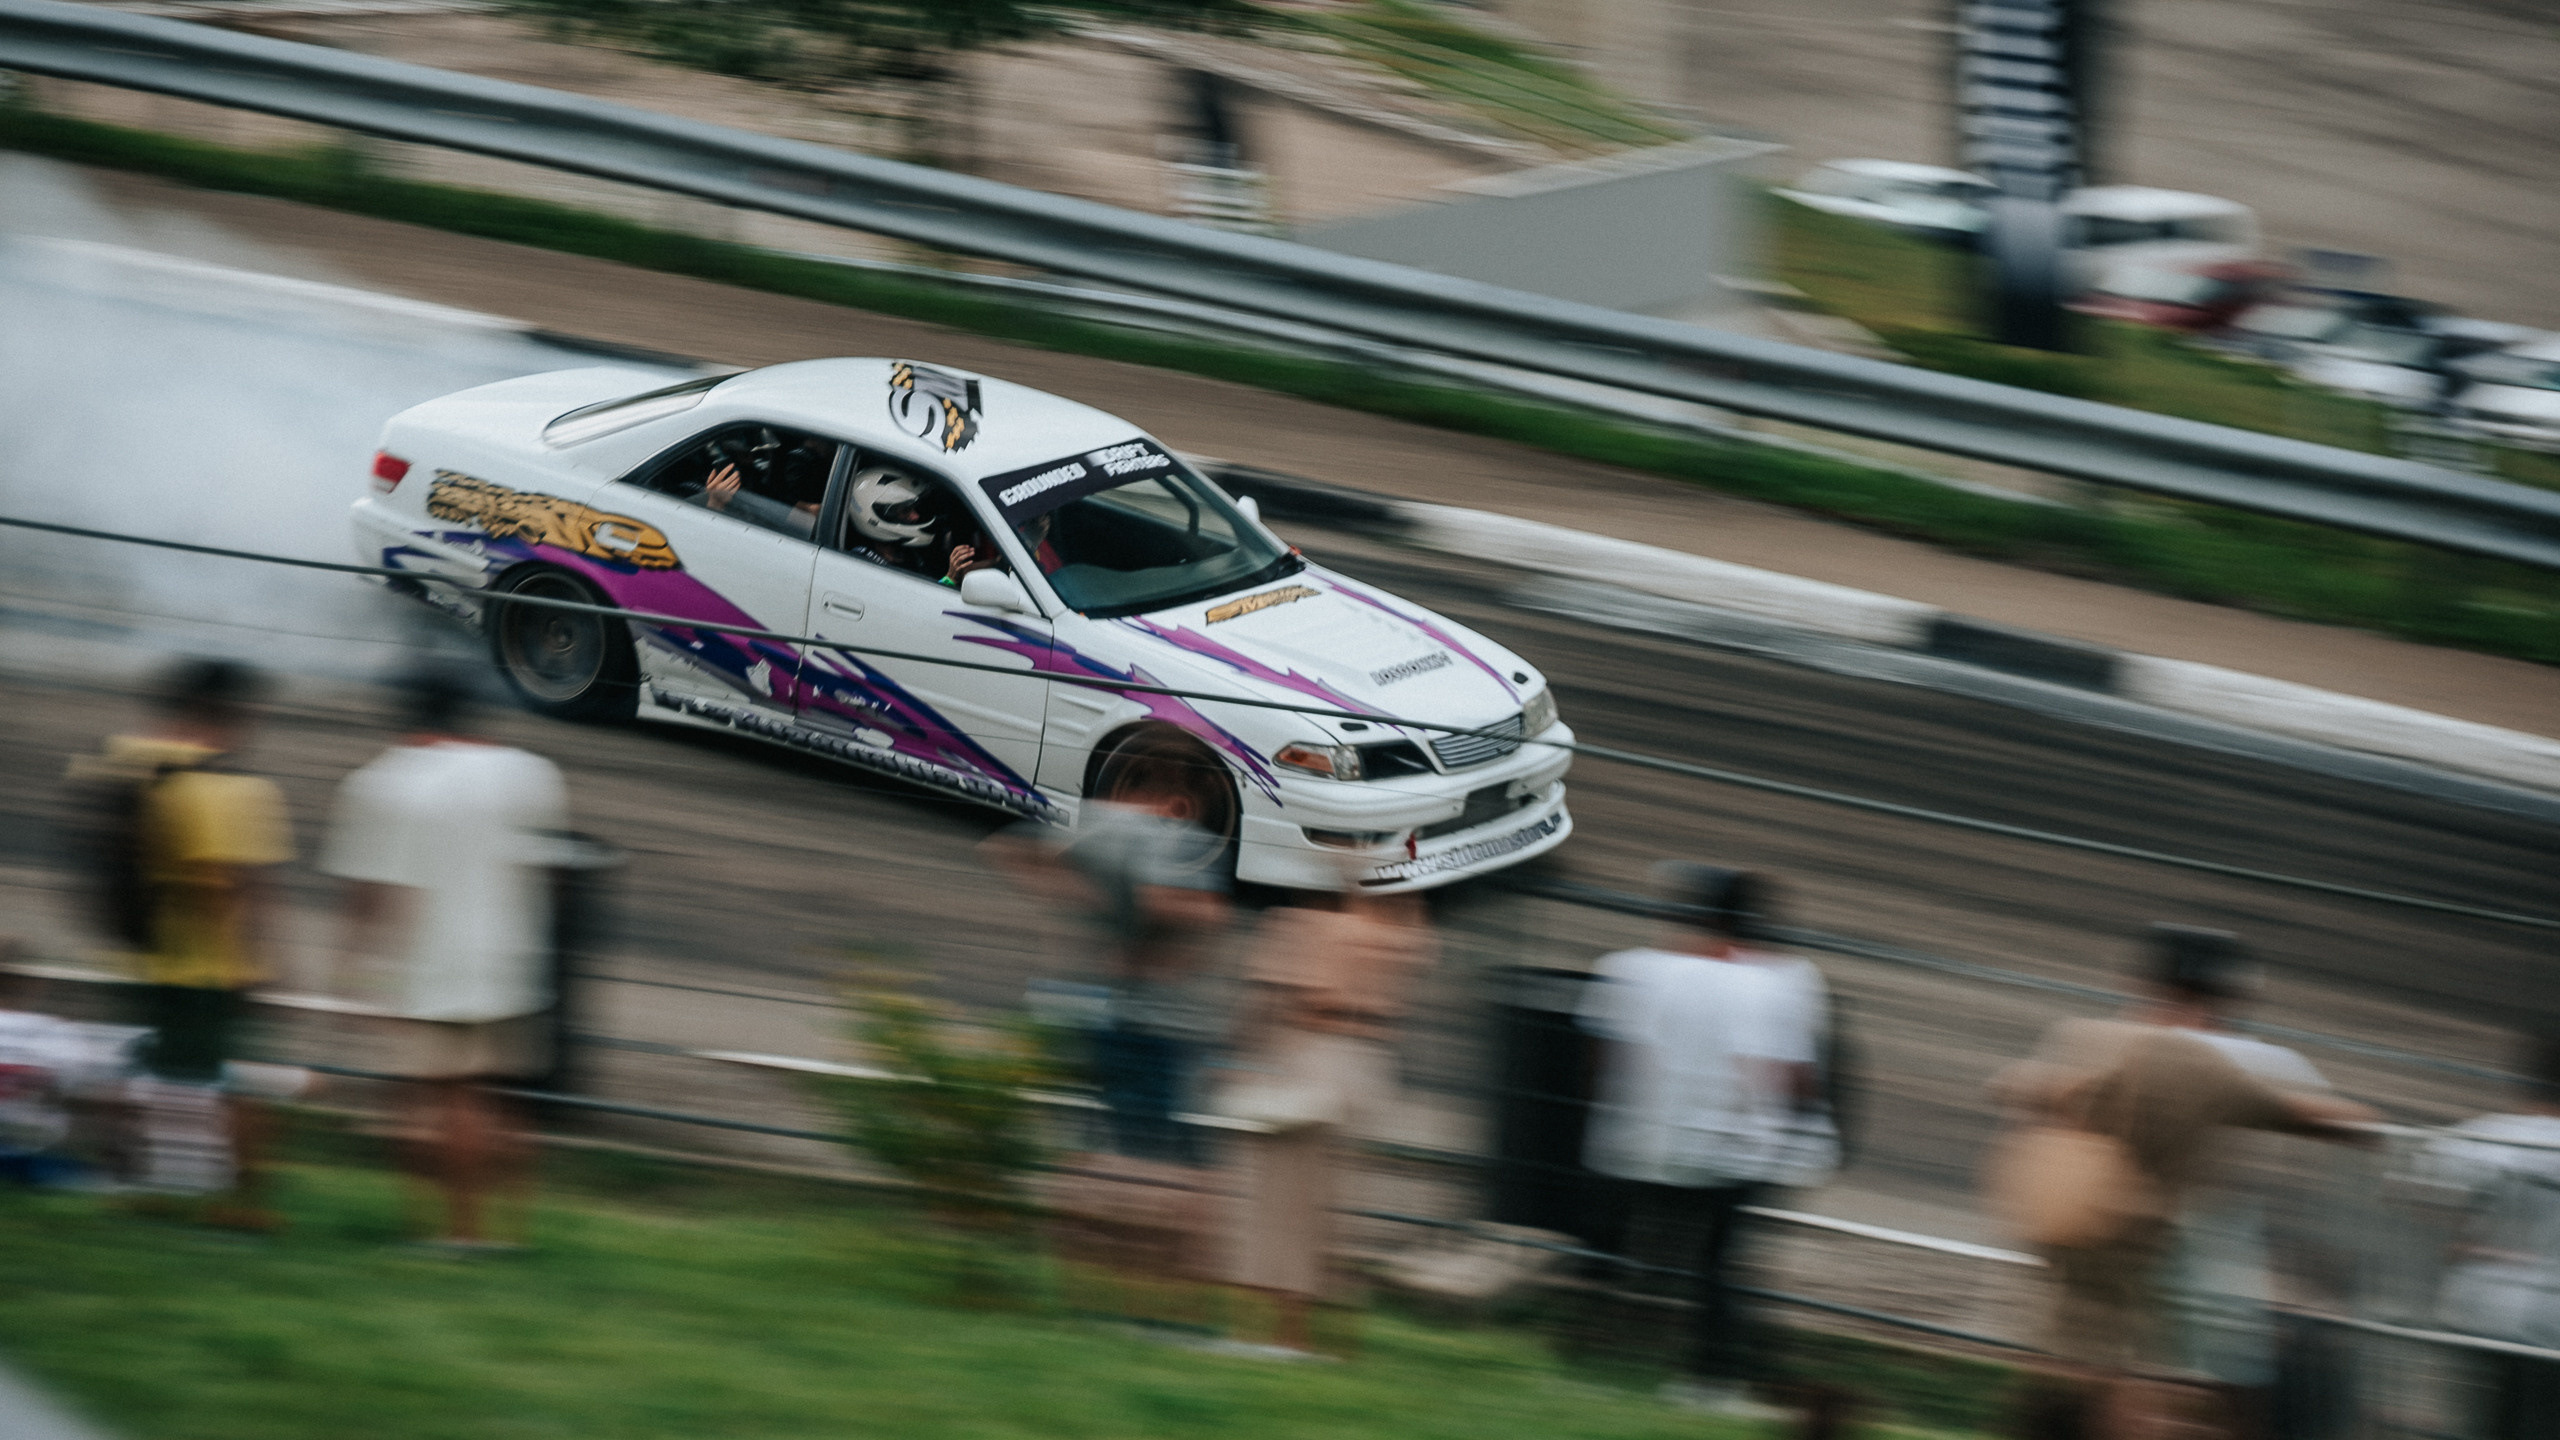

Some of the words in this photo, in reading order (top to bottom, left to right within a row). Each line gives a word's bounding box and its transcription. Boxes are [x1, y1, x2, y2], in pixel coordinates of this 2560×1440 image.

[1102, 442, 1150, 463] DRIFT
[1102, 453, 1171, 478] FIGHTERS
[998, 461, 1088, 507] GROUNDED
